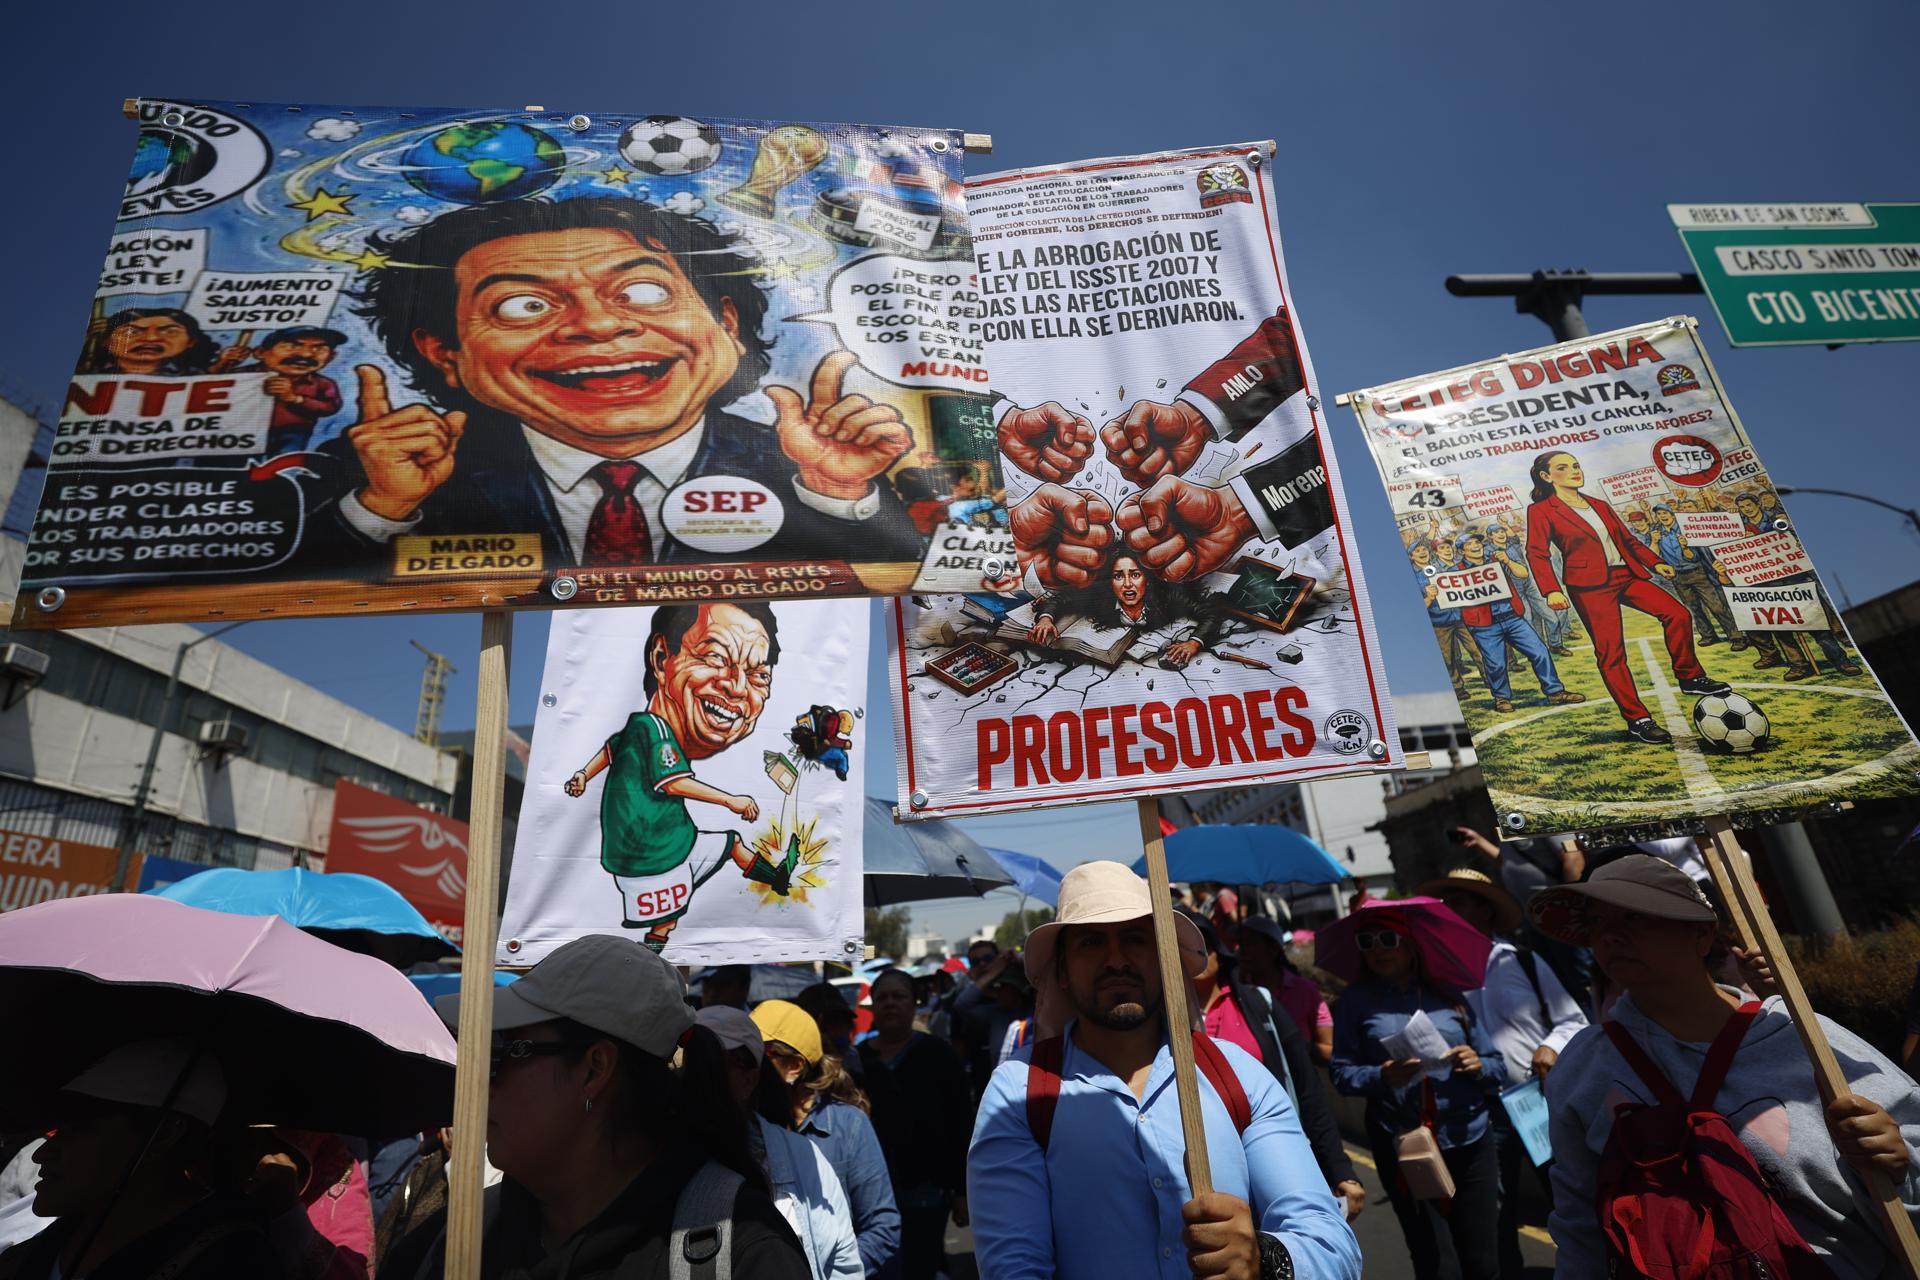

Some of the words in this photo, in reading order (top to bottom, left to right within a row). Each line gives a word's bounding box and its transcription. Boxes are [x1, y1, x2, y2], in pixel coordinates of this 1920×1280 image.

[1026, 181, 1071, 192] NACIONAL
[1058, 185, 1112, 196] EDUCACIÓN
[969, 201, 1031, 217] ORDINADORA
[1033, 196, 1073, 206] ESTATAL
[1111, 185, 1185, 199] TRABAJADORES
[996, 211, 1009, 219] DE
[1026, 204, 1080, 214] EDUCACIÓN
[1098, 195, 1150, 208] GUERRERO
[1025, 217, 1071, 227] COLECTIVA
[1097, 212, 1124, 220] CETEG
[1125, 208, 1152, 218] DIGNA
[1688, 208, 1741, 223] RIBERA
[1767, 208, 1799, 222] SAN
[1800, 207, 1850, 222] COSME
[971, 232, 1003, 243] QUIEN
[1006, 226, 1062, 238] GOBIERNE,
[1088, 217, 1144, 231] DERECHOS
[1147, 215, 1159, 223] SE
[1162, 208, 1223, 221] DEFIENDEN!
[108, 236, 193, 255] ACIÓN
[998, 249, 1027, 271] LA
[1034, 230, 1184, 269] ABROGACIÓN
[1191, 230, 1222, 252] DE
[115, 255, 168, 270] LEY
[1731, 250, 1803, 271] CASCO
[1807, 248, 1876, 269] SANTO
[206, 278, 333, 293] ¡AUMENTO
[982, 272, 1022, 295] LEY
[1027, 269, 1066, 291] DEL
[1072, 262, 1143, 288] ISSSTE
[1147, 256, 1200, 281] 2007
[1205, 256, 1218, 273] Y
[205, 294, 320, 307] SALARIAL
[850, 282, 942, 300] POSIBLE
[952, 290, 979, 302] AD
[1022, 292, 1061, 315] LAS
[1069, 278, 1222, 313] AFECTACIONES
[209, 309, 306, 324] JUSTO!
[868, 299, 894, 311] EL
[903, 299, 939, 315] FIN
[1747, 290, 1807, 325] CTO
[856, 314, 960, 333] ESCOLAR
[982, 319, 1026, 342] CON
[1032, 315, 1082, 339] ELLA
[1087, 314, 1113, 337] SE
[1117, 300, 1246, 333] DERIVARON.
[865, 330, 909, 344] LOS
[920, 347, 982, 364] VEAN
[1508, 336, 1665, 390] DIGNA
[901, 361, 989, 383] MUND
[1221, 365, 1264, 401] AMLO
[62, 379, 235, 417] NTE
[1423, 380, 1650, 436] PRESIDENTA,
[56, 419, 175, 437] EFENSA
[184, 416, 222, 432] DE
[1402, 446, 1424, 458] EL
[1562, 413, 1587, 428] SU
[1591, 401, 1673, 422] CANCHA,
[53, 440, 90, 456] OS
[101, 435, 256, 455] DERECHOS
[1430, 454, 1457, 467] CON
[1459, 449, 1483, 460] LOS
[1483, 429, 1600, 457] TRABAJADORES
[1603, 427, 1612, 436] O
[1613, 425, 1634, 434] CON
[1635, 422, 1654, 431] LAS
[1655, 409, 1713, 430] AFORES?
[1663, 450, 1712, 462] CETEG
[1724, 450, 1753, 468] TEG
[1638, 475, 1653, 483] LEY
[1720, 462, 1760, 484] CETEG!
[60, 485, 99, 501] ES
[111, 481, 237, 499] POSIBLE
[1261, 465, 1327, 511] Morena
[1389, 483, 1412, 492] NOS
[1416, 478, 1460, 489] FALTAN
[1464, 492, 1486, 501] POR
[1487, 486, 1512, 496] UNA
[1612, 489, 1629, 497] DEL
[683, 490, 768, 513] SEP
[1408, 489, 1446, 508] 43
[138, 500, 254, 518] CLASES
[1478, 504, 1513, 517] DIGNA
[1687, 515, 1730, 523] CLAUDIA
[30, 528, 77, 544] LOS
[88, 520, 285, 541] TRABAJADORES
[1683, 523, 1740, 531] SHEINBAUM
[1685, 530, 1745, 539] CUMPLENOS
[24, 550, 60, 567] OR
[69, 547, 125, 564] SUS
[134, 542, 276, 561] DERECHOS
[429, 536, 516, 555] MARIO
[1713, 533, 1788, 556] PRESIDENTA
[1723, 548, 1770, 566] CUMPLE
[1772, 542, 1792, 555] TU
[407, 553, 535, 572] DELGADO
[1727, 558, 1784, 576] PROMESA
[1786, 550, 1805, 562] DE
[579, 573, 606, 586] EN
[615, 572, 637, 585] EL
[646, 569, 725, 583] MUNDO
[734, 568, 757, 581] AL
[1436, 567, 1498, 589] CETEG
[1743, 564, 1803, 584] CAMPAÑA
[595, 589, 625, 602] DE
[637, 584, 713, 600] MARIO
[720, 579, 826, 596] DELGADO
[1446, 584, 1502, 602] DIGNA
[1732, 588, 1814, 603] ABROGACIÓN
[1752, 607, 1805, 625] ¡YA!
[1330, 714, 1362, 728] CETEG
[976, 686, 1317, 791] PROFESORES
[0, 834, 61, 869] ERA
[636, 883, 688, 917] SEP
